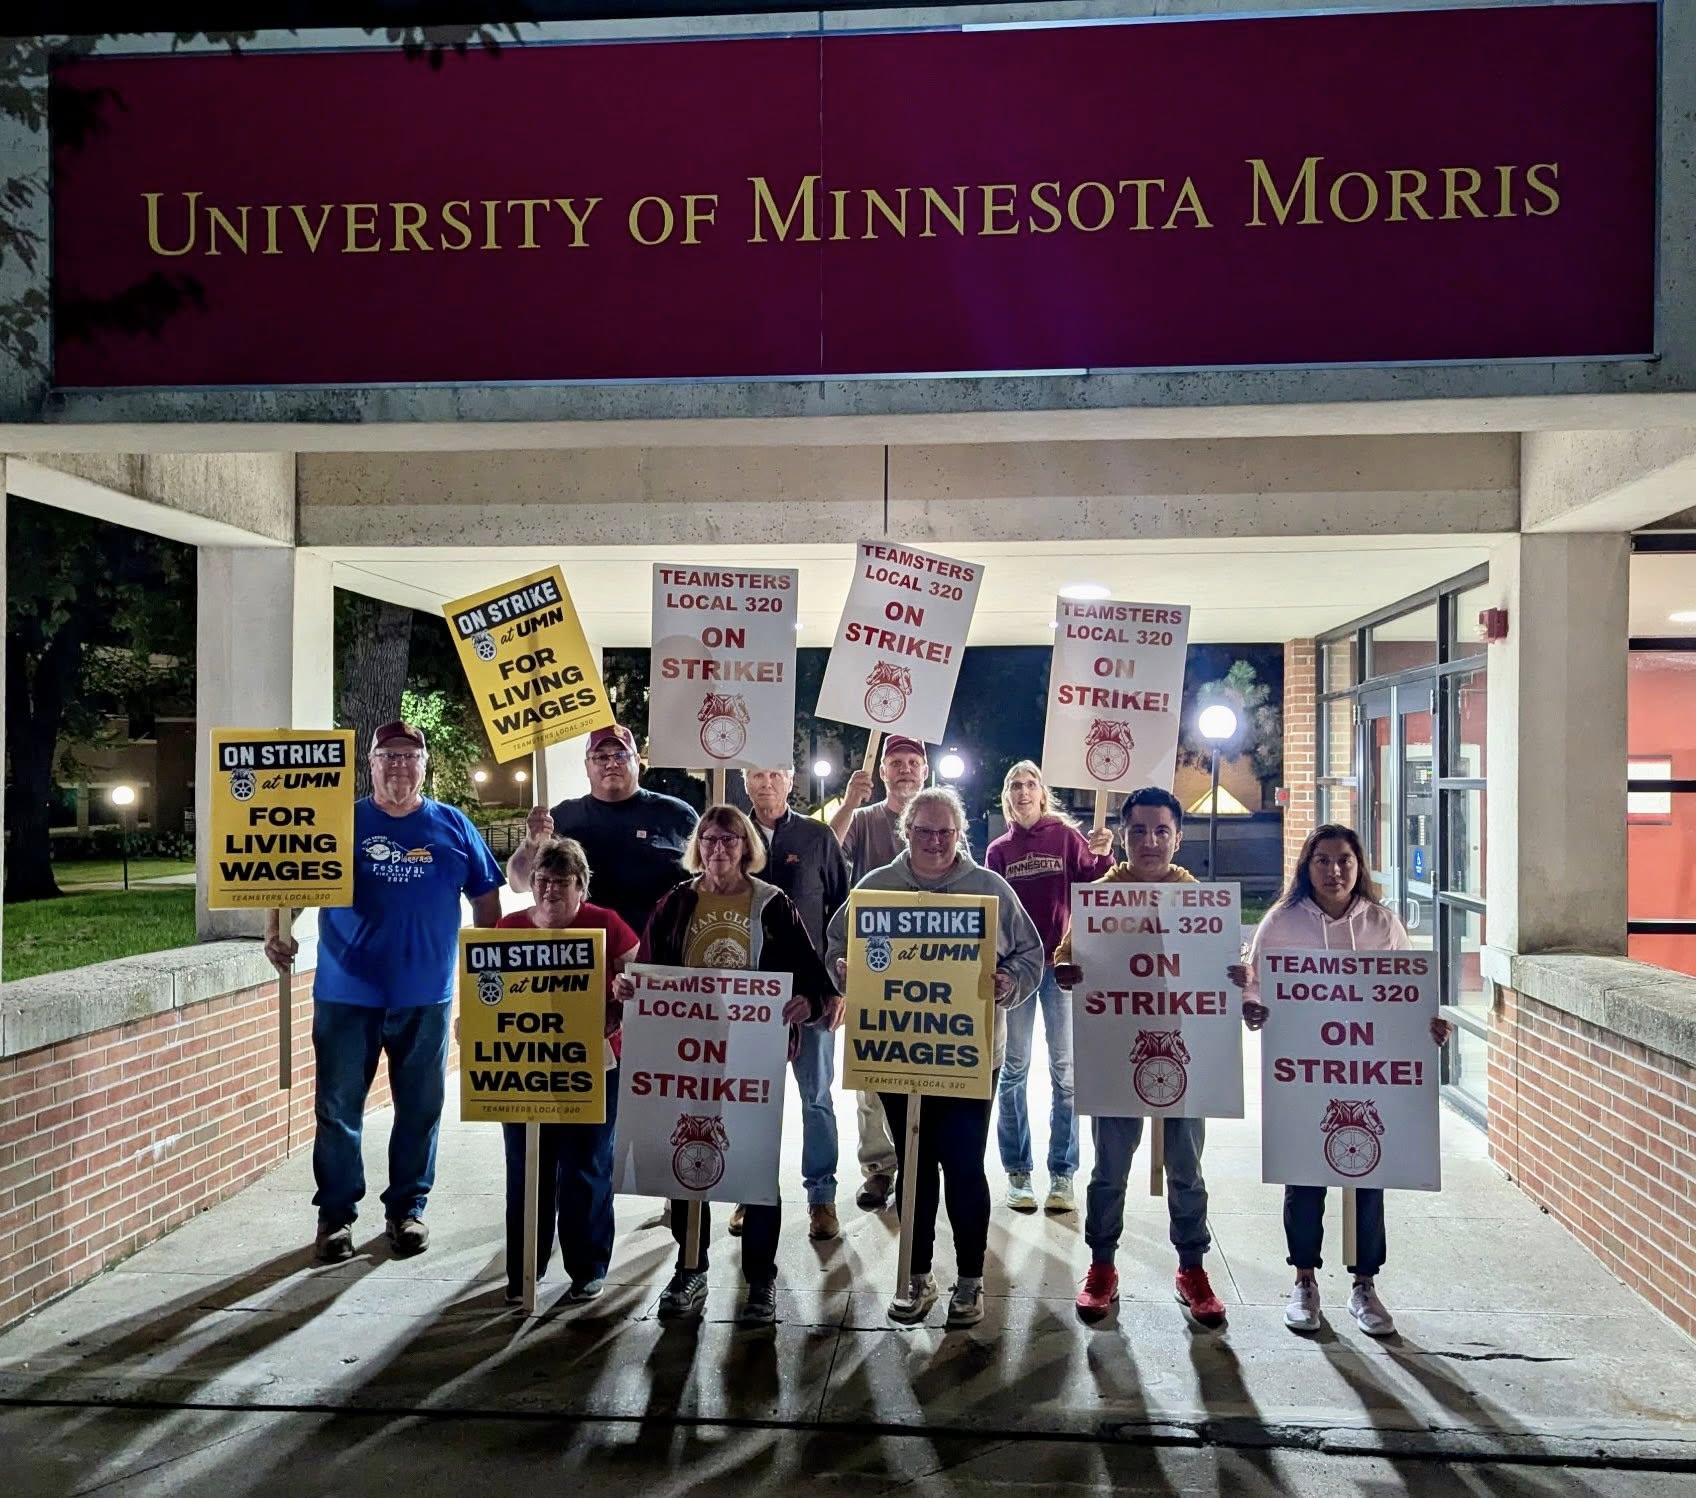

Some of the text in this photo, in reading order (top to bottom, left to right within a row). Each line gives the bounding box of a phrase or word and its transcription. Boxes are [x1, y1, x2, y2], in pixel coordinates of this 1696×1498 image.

[141, 156, 1561, 257] UNIVERSITY OF MINNESOTA MORRIS
[862, 544, 975, 582] TEAMSTERS
[660, 570, 791, 590] TEAMSTERS
[866, 565, 962, 601] LOCAL 320
[458, 581, 557, 635] ON STRIKE
[667, 593, 783, 612] LOCAL 320
[1062, 602, 1182, 624] TEAMSTERS
[501, 607, 563, 644] at UMN
[885, 602, 924, 627] ON
[702, 627, 745, 648] ON
[846, 622, 952, 664] STRIKE!
[1067, 624, 1172, 646] LOCAL 320
[498, 647, 557, 680] FOR
[662, 658, 783, 683] STRIKE!
[1094, 657, 1134, 678] ON
[488, 666, 584, 711] LIVING
[1058, 685, 1169, 712] STRIKE!
[493, 688, 596, 735] WAGES
[556, 725, 578, 740] LOCAL
[224, 743, 340, 766] ON STRIKE
[262, 772, 340, 789] at UMN
[250, 807, 315, 826] FOR
[226, 834, 337, 853] LIVING
[219, 861, 342, 881] WAGES
[691, 911, 751, 934] FAN CLU
[861, 911, 980, 933] ON STRIKE
[1088, 917, 1223, 934] LOCAL 320
[472, 943, 589, 968] ON STRIKE
[898, 944, 980, 961] at UMN
[1130, 954, 1180, 977] ON
[1266, 955, 1428, 975] TEAMSTERS
[510, 974, 589, 993] at UMN
[631, 972, 781, 997] TEAMSTERS
[884, 980, 952, 1004] FOR
[1277, 983, 1419, 1002] LOCAL 320
[639, 999, 771, 1022] LOCAL 320
[1085, 991, 1226, 1015] STRIKE!
[498, 1012, 564, 1033] FOR
[860, 1009, 974, 1036] LIVING
[1321, 1021, 1374, 1045] ON
[475, 1042, 586, 1063] LIVING
[678, 1038, 727, 1063] ON
[853, 1039, 979, 1067] WAGES
[469, 1070, 592, 1092] WAGES
[865, 1076, 915, 1086] TEAMSTERS
[918, 1079, 945, 1089] LOCAL
[1274, 1058, 1423, 1085] STRIKE!
[632, 1071, 770, 1103] STRIKE!
